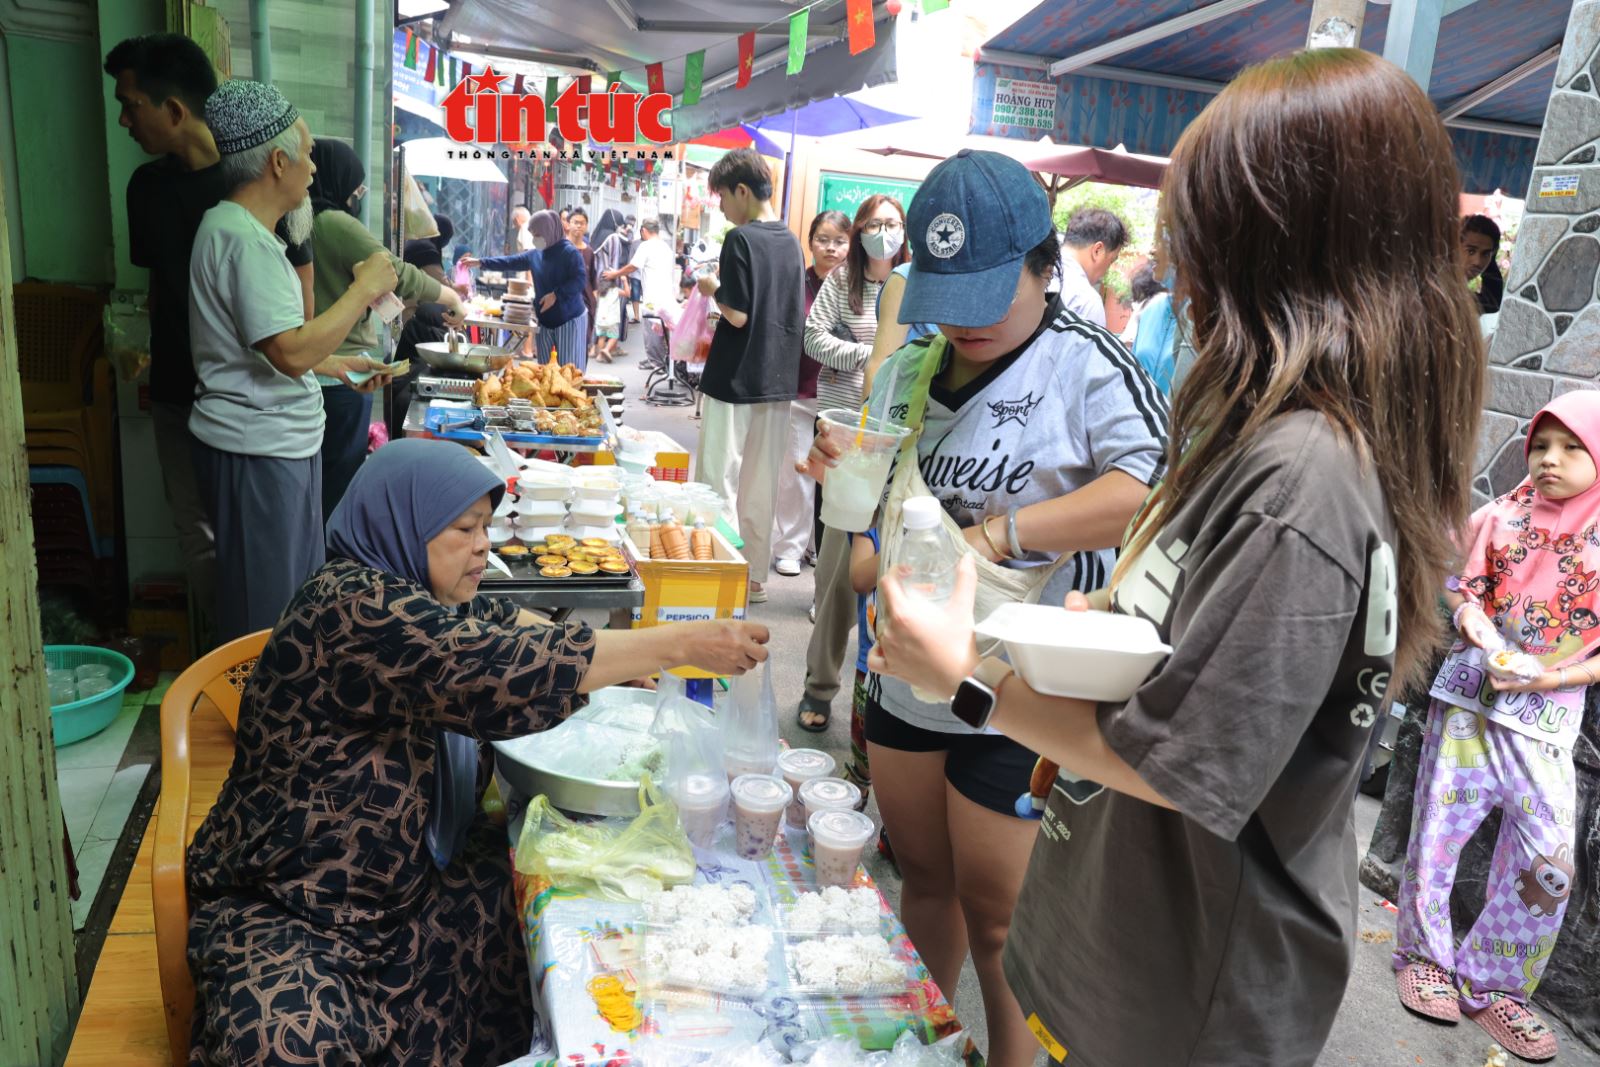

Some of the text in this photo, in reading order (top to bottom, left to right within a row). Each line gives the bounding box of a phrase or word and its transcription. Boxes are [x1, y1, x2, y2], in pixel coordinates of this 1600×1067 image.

[995, 92, 1031, 107] HOÀNG
[1034, 97, 1055, 109] HUY
[665, 613, 710, 621] PEPSICO
[1472, 934, 1541, 958] LABUBU
